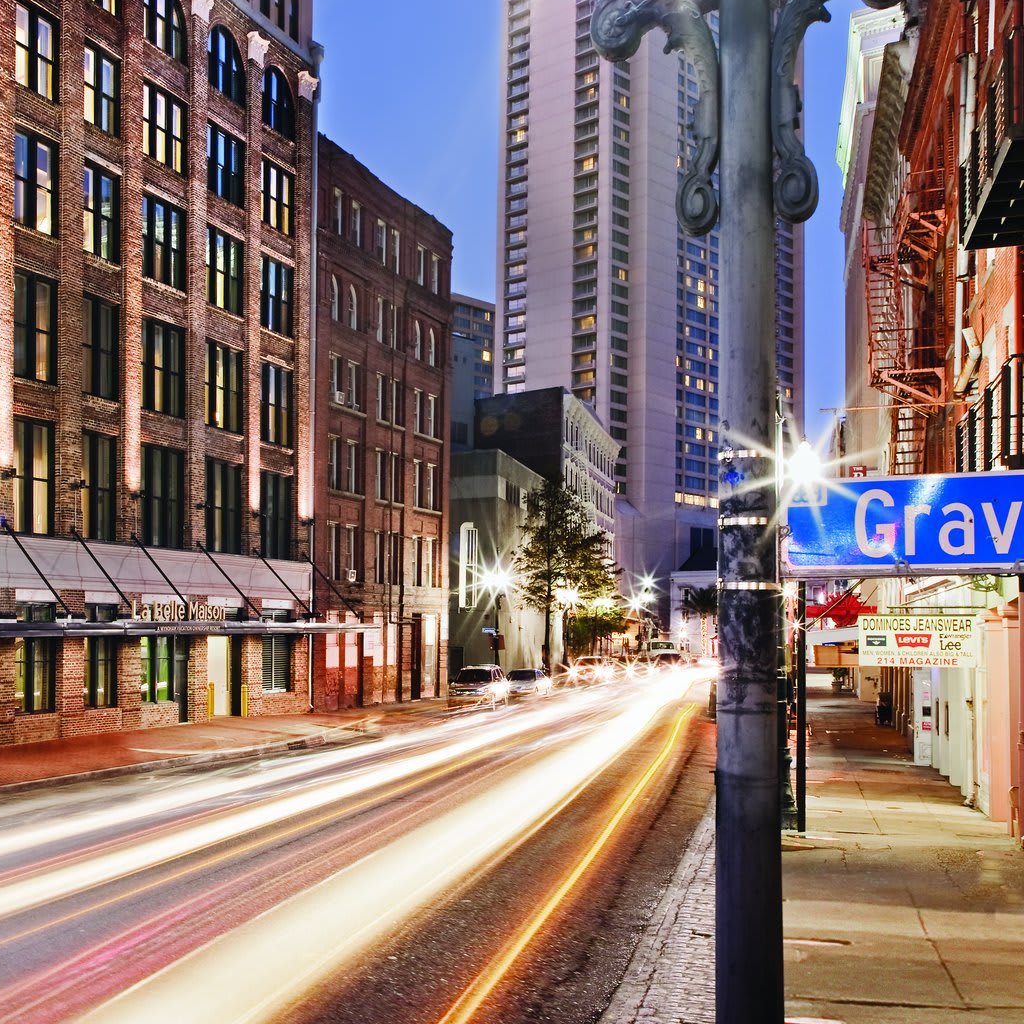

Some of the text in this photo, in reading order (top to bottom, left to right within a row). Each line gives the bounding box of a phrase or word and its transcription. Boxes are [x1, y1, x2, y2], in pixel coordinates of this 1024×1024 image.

[854, 488, 1023, 558] Grav
[132, 600, 226, 621] La Belle Maison
[862, 618, 972, 632] DOMINOES JEANSWEAR
[940, 640, 962, 651] Lee
[877, 657, 958, 666] 214 MAGAZINE
